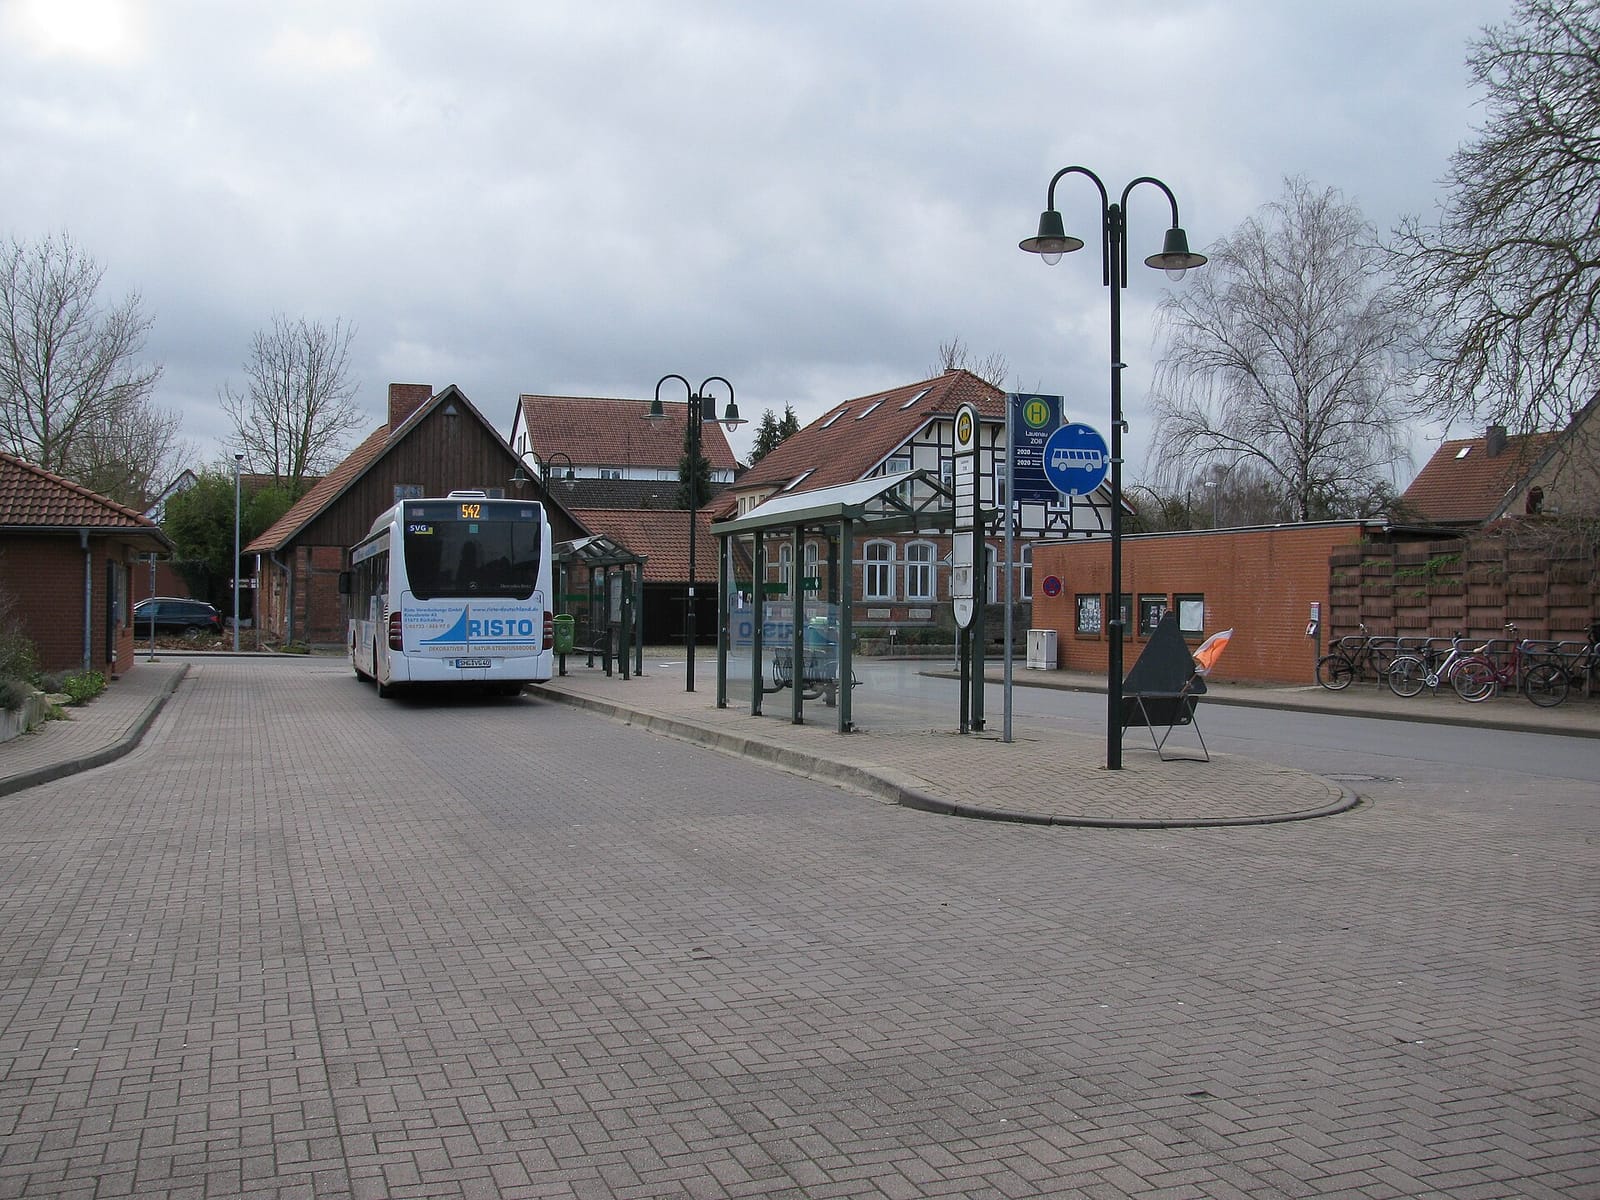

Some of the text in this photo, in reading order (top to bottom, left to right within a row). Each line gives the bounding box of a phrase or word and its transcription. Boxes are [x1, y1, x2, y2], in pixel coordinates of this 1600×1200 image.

[1031, 404, 1043, 421] H
[1025, 430, 1049, 438] Lauenau
[461, 503, 480, 519] 542
[409, 524, 427, 532] SVG
[469, 619, 533, 637] RISTO
